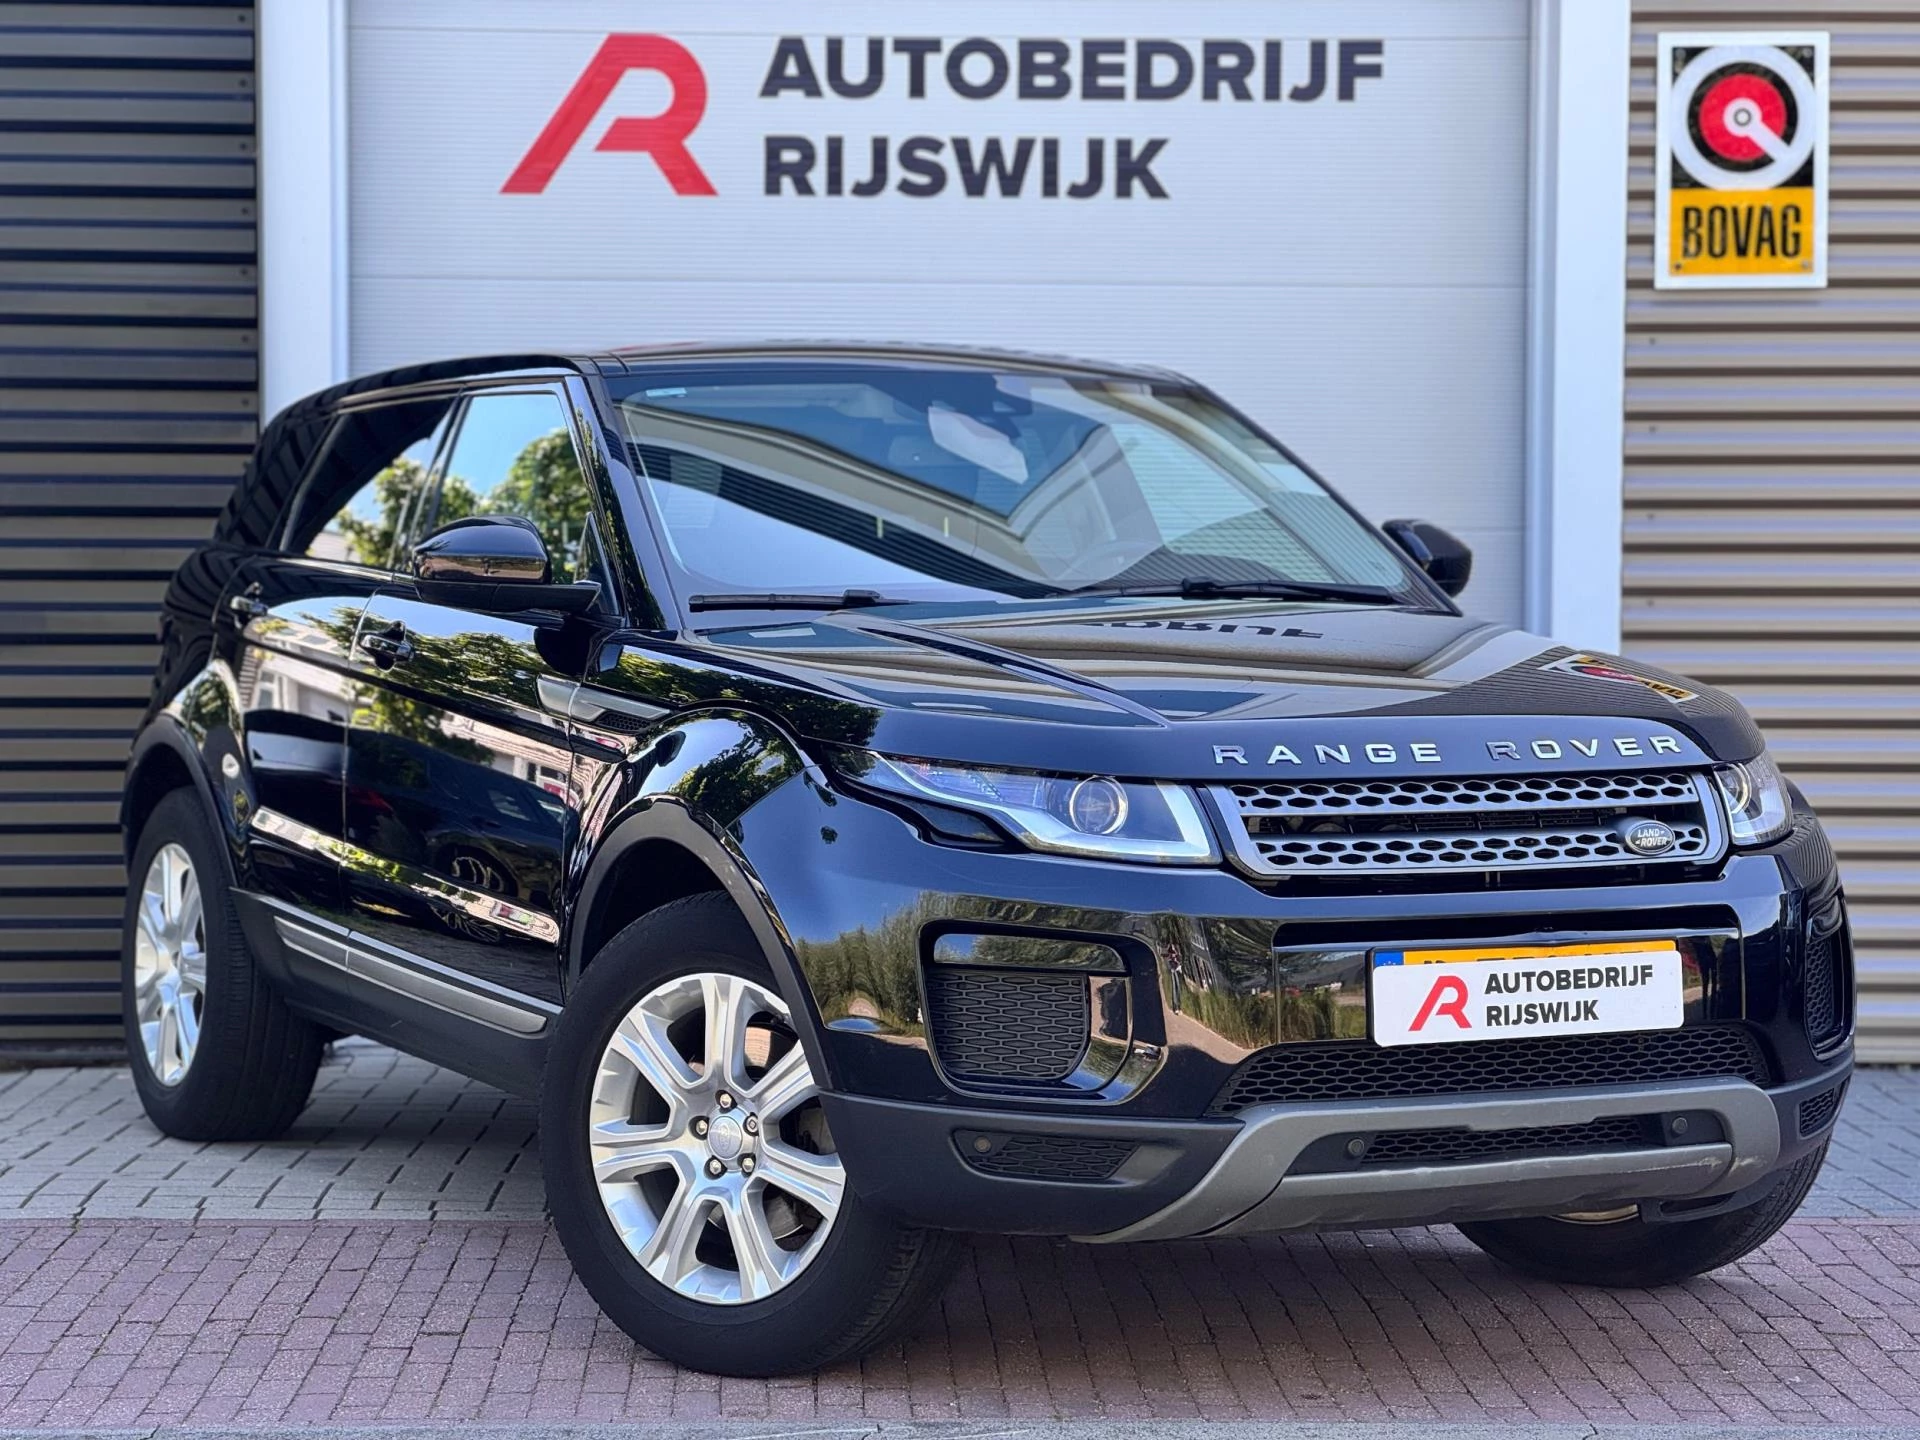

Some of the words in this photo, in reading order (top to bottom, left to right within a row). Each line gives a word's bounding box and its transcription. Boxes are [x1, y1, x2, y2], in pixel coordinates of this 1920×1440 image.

[759, 37, 1384, 101] AUTOBEDRIJF
[764, 135, 1171, 199] RIJSWIJK
[1683, 204, 1802, 258] BOVAG
[1212, 743, 1442, 765] RANGE
[1486, 735, 1682, 761] ROVER
[1637, 828, 1660, 838] LAND
[1640, 836, 1668, 847] ROVER
[1484, 965, 1654, 995] AUTOBEDRIJF
[1486, 1000, 1600, 1027] RIJSWIJK
